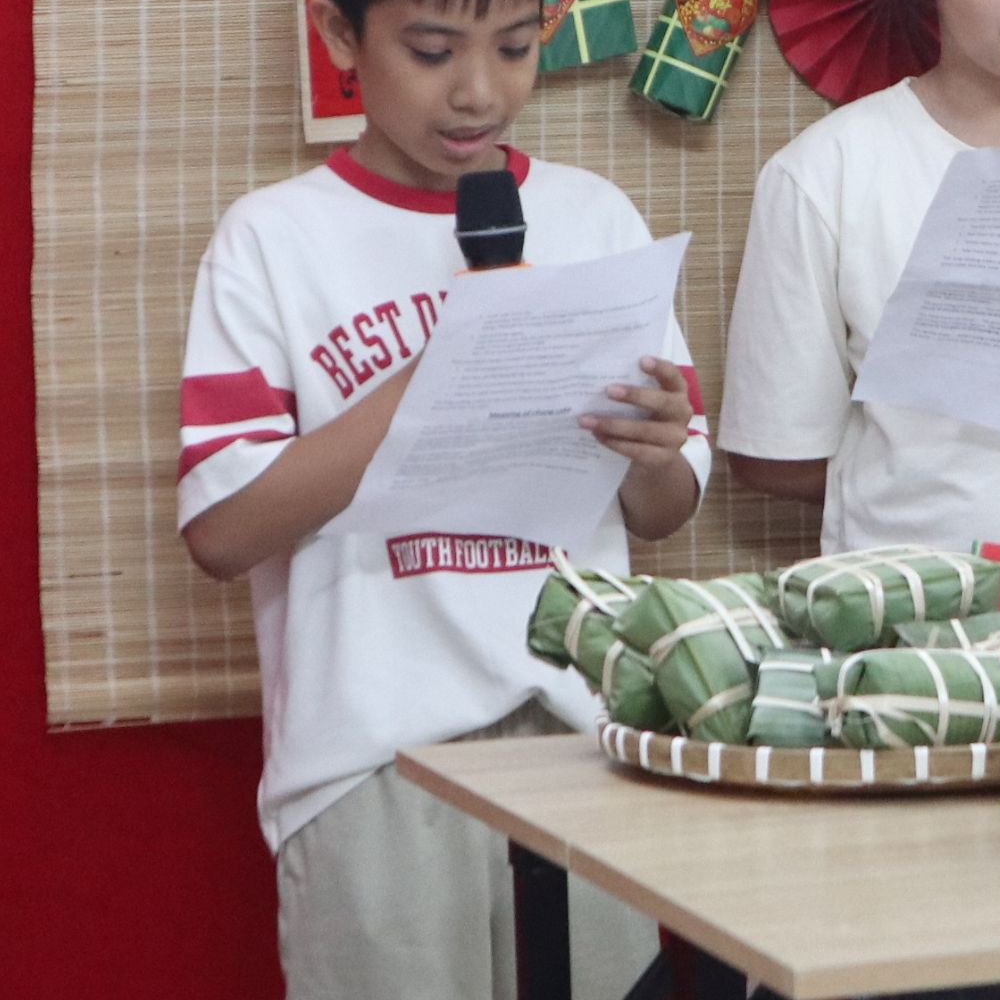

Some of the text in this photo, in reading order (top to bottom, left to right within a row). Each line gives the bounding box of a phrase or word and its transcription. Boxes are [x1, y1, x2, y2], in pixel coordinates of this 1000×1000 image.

[310, 300, 412, 400] BEST
[410, 290, 448, 340] D
[392, 537, 558, 573] YOUTH FOOTBAL
